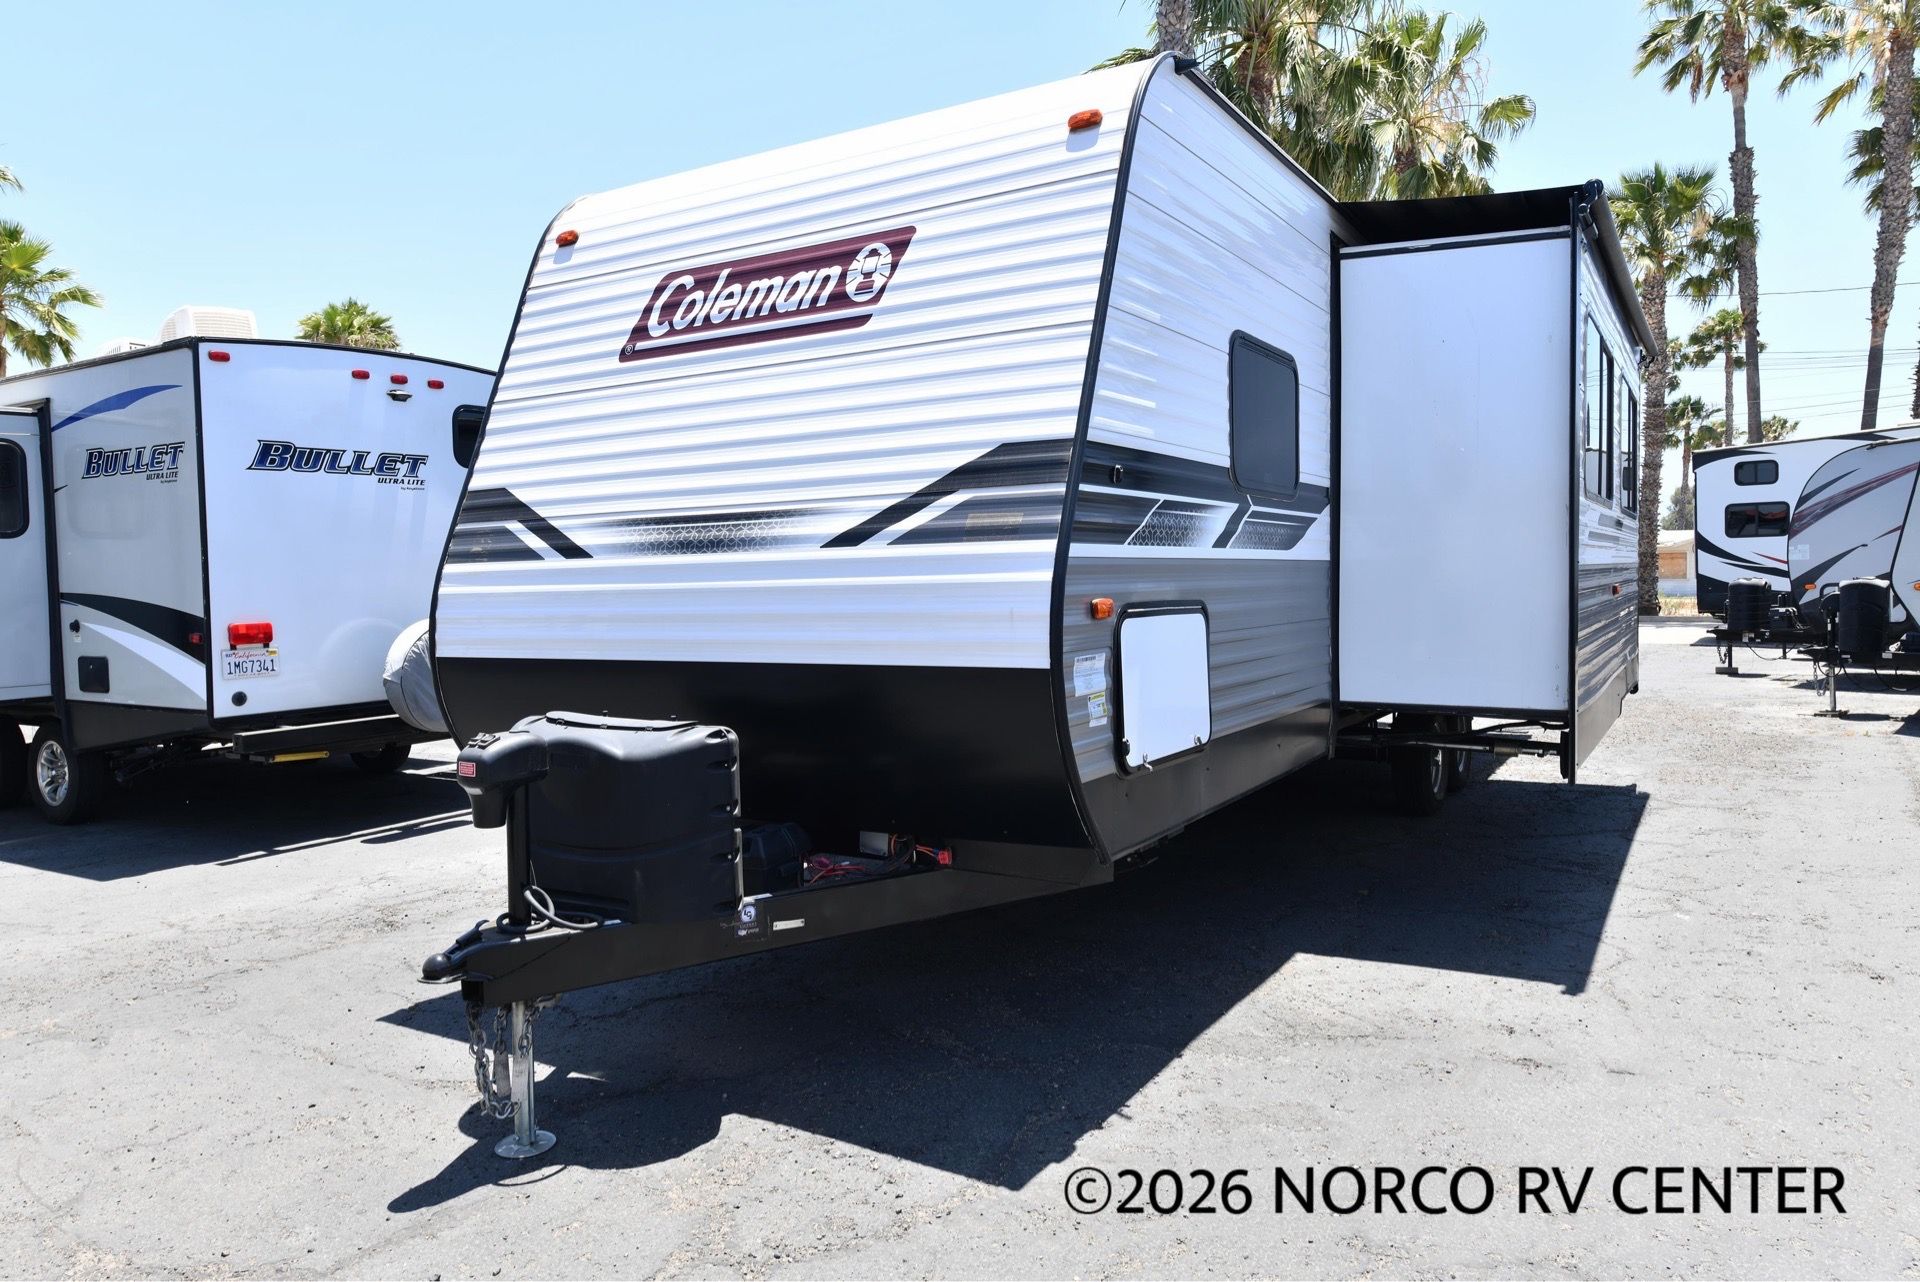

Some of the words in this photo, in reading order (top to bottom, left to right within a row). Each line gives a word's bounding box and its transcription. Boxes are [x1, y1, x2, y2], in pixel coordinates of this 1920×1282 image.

[647, 265, 843, 338] Coleman
[81, 441, 186, 480] BULLET
[246, 439, 429, 478] BULLET
[146, 472, 164, 480] ULTRA
[165, 471, 178, 479] LITE
[377, 477, 404, 485] ULTRA
[227, 659, 276, 675] 1MG7341
